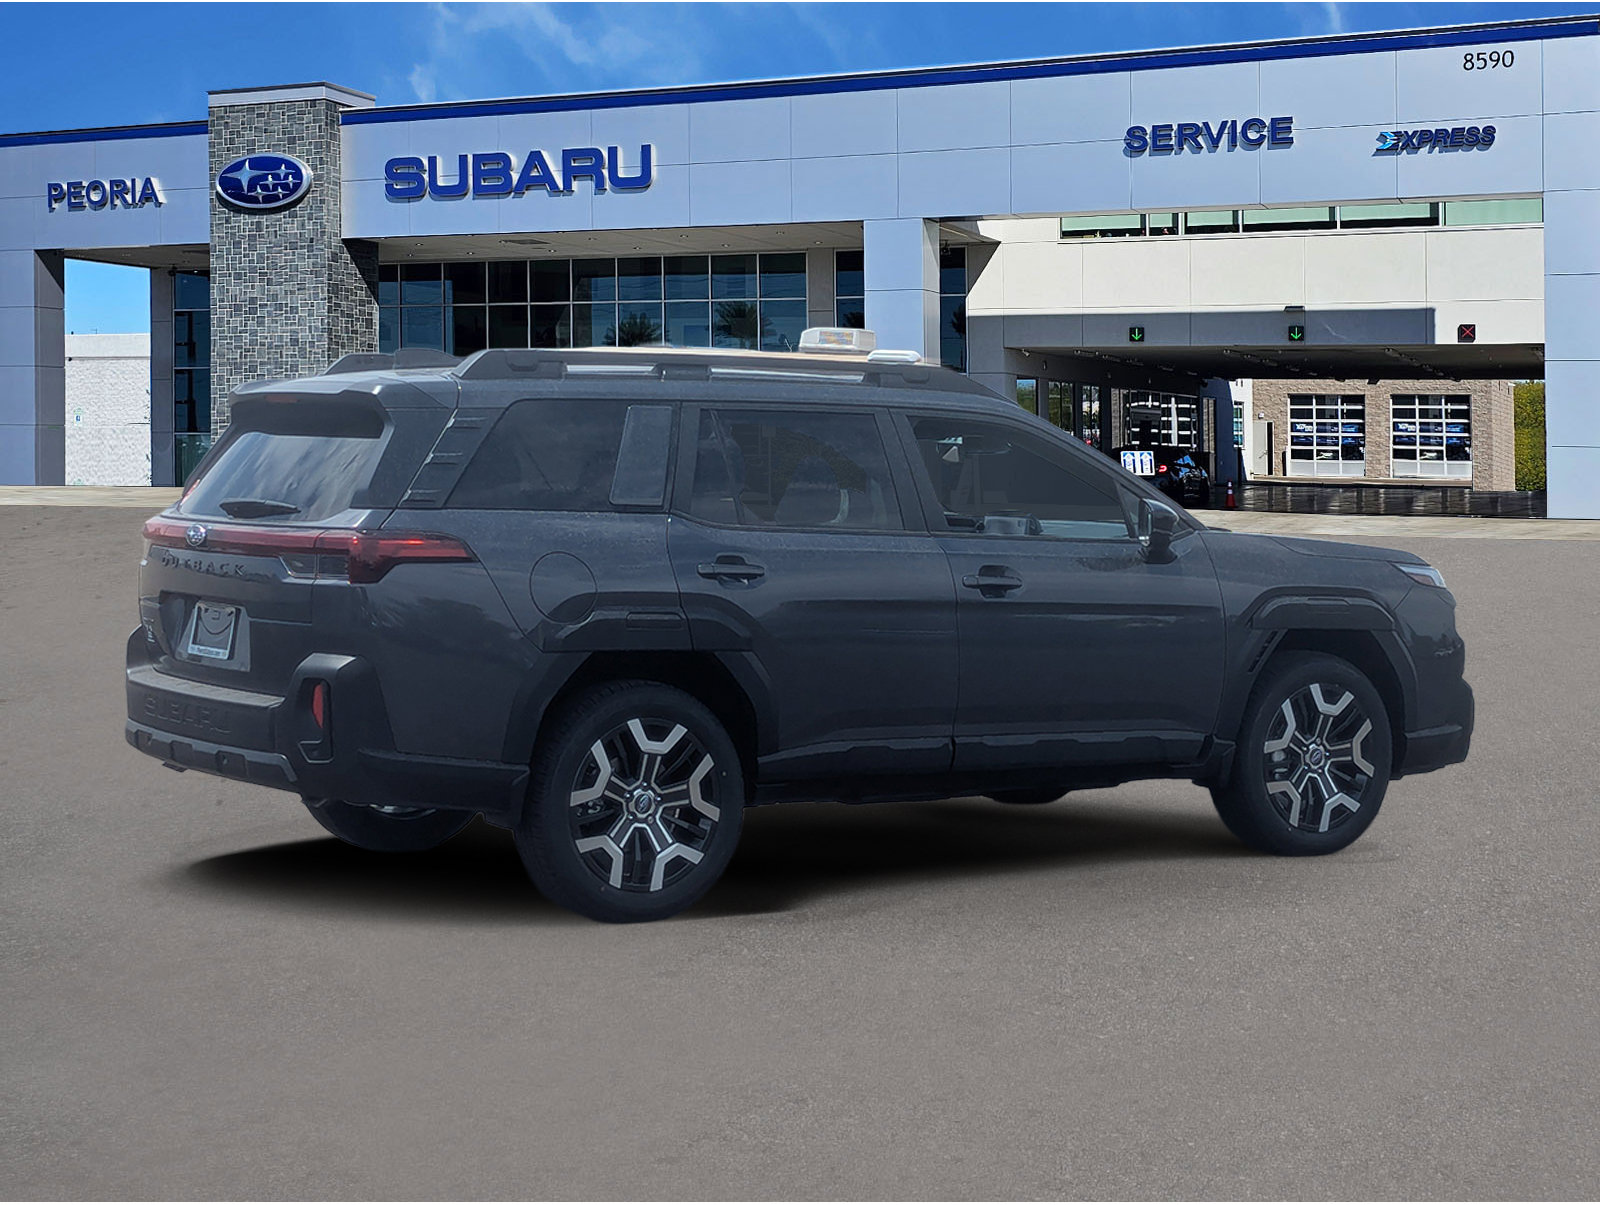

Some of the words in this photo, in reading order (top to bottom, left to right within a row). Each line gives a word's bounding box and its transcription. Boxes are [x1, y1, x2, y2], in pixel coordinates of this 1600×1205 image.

[1463, 50, 1514, 70] 8590
[1125, 116, 1293, 152] SERVICE
[1376, 124, 1497, 151] EXPRESS
[385, 143, 653, 201] SUBARU
[48, 177, 161, 210] PEORIA
